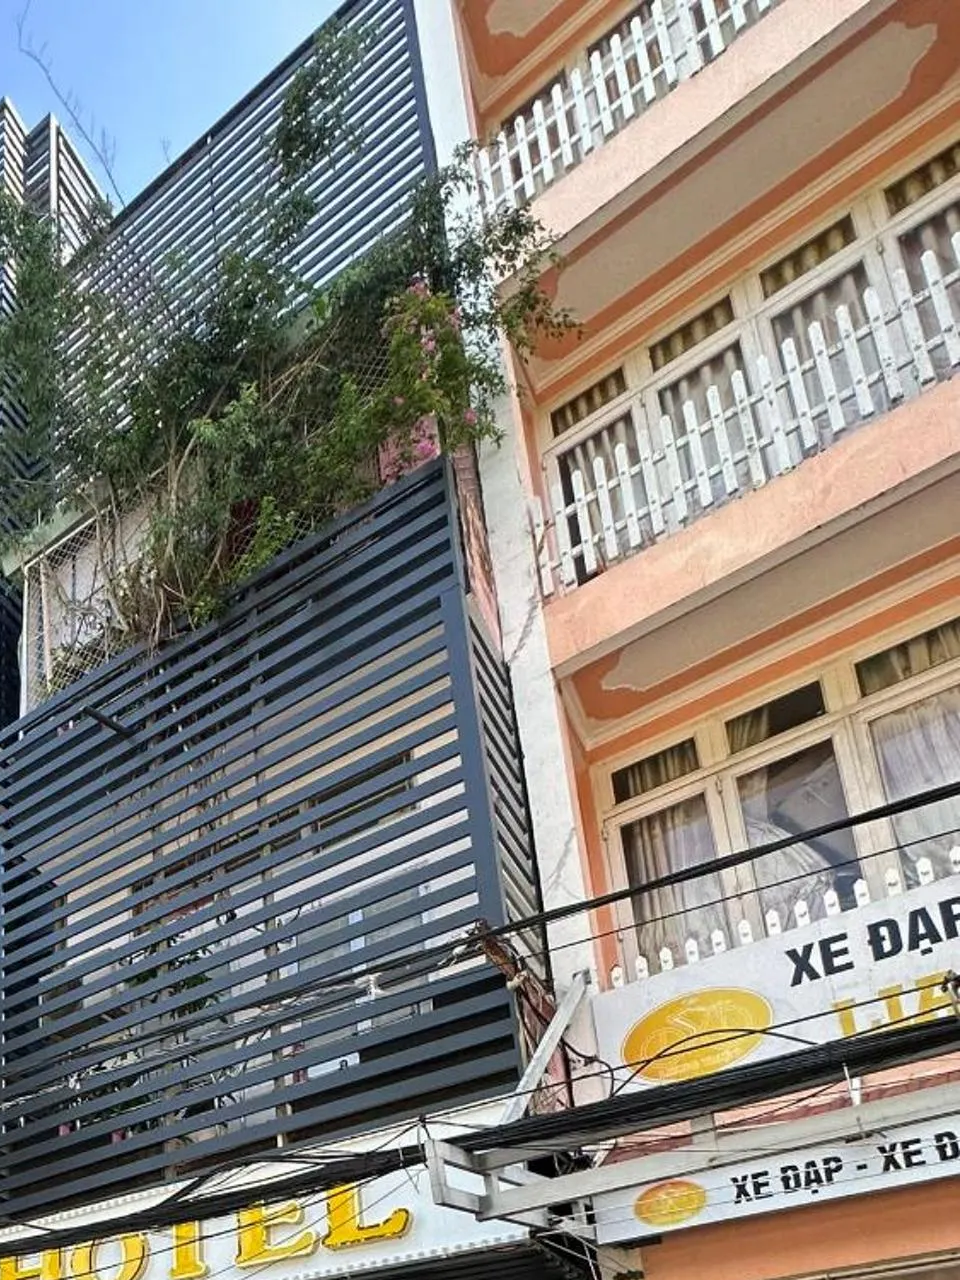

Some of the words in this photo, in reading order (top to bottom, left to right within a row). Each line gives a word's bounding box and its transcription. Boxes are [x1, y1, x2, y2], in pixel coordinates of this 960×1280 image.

[785, 932, 854, 987] XE
[731, 1170, 773, 1204] XE
[877, 1137, 927, 1173] XE
